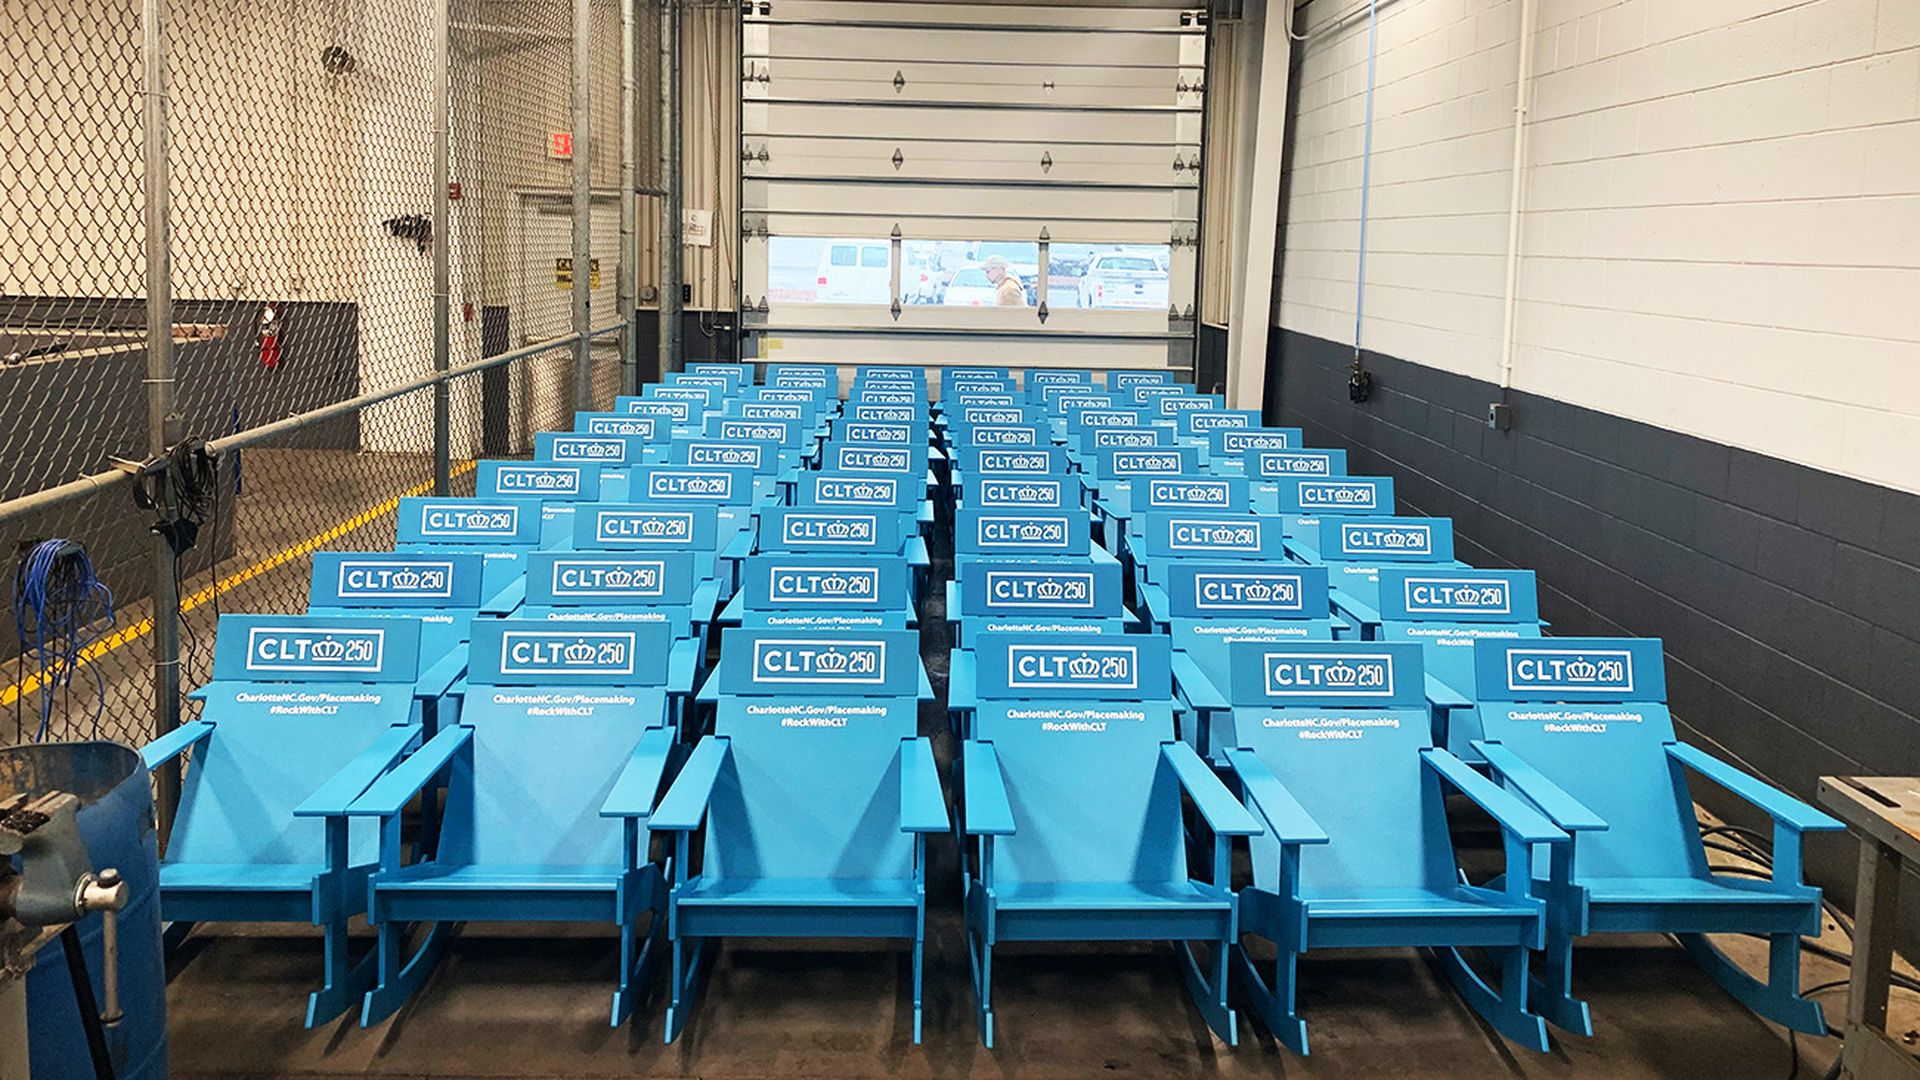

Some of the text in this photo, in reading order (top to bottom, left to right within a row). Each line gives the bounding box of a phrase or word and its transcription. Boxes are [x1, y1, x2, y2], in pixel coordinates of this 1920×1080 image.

[594, 423, 649, 434] CLT 250
[727, 427, 781, 438] CLT 250
[852, 429, 905, 440] CLT 250
[978, 432, 1030, 443] CLT 250
[1100, 435, 1152, 446] CLT 250
[1229, 437, 1282, 449] CLT 250
[559, 444, 620, 456] CLT 250
[694, 450, 755, 463] CLT 250
[845, 453, 905, 466] CLT 250
[985, 457, 1044, 468] CLT 250
[1119, 458, 1177, 470] CLT 250
[1266, 459, 1324, 471] CLT 250
[504, 474, 573, 488] CLT 250
[656, 478, 725, 492] CLT 250
[822, 484, 890, 498] CLT 250
[988, 487, 1054, 500] CLT 250
[1157, 487, 1223, 501] CLT 250
[1305, 489, 1370, 502] CLT 250
[430, 513, 510, 528] CLT 250
[605, 520, 685, 535] CLT 250
[791, 522, 869, 537] CLT 250
[985, 524, 1061, 539] CLT 250
[1177, 528, 1253, 544] CLT 250
[1349, 532, 1424, 547] CLT 250
[348, 571, 443, 588] CLT 250
[562, 570, 655, 587] CLT 250
[779, 576, 870, 593] CLT 250
[996, 581, 1085, 599] CLT 250
[1204, 583, 1294, 601] CLT 250
[1414, 587, 1502, 604] CLT 250
[259, 639, 372, 660] CLT 250
[512, 643, 624, 664] CLT 250
[764, 651, 875, 672] CLT 250
[1019, 656, 1127, 678] CLT 250
[1275, 665, 1383, 685] CLT 250
[1518, 660, 1623, 681] CLT 250
[236, 692, 381, 704] CharlotteNC.Gov/Placemaking
[493, 694, 635, 706] CharlotteNC.Gov/Placemaking
[270, 705, 338, 715] #RockWithCLT
[527, 707, 593, 716] #RockWithCLT
[747, 705, 887, 717] CharlotteNC.Gov/Placemaking
[1007, 709, 1145, 721] CharlotteNC.Gov/Placemaking
[1508, 711, 1642, 722] CharlotteNC.Gov/Placemaking
[781, 718, 847, 727] #RockWithCLT
[1042, 722, 1106, 732] #RockWithCLT
[1263, 717, 1399, 729] CharlotteNC.Gov/Placemaking
[1544, 724, 1606, 733] #RockWithCLT
[1299, 730, 1363, 740] #RockWithCLT
